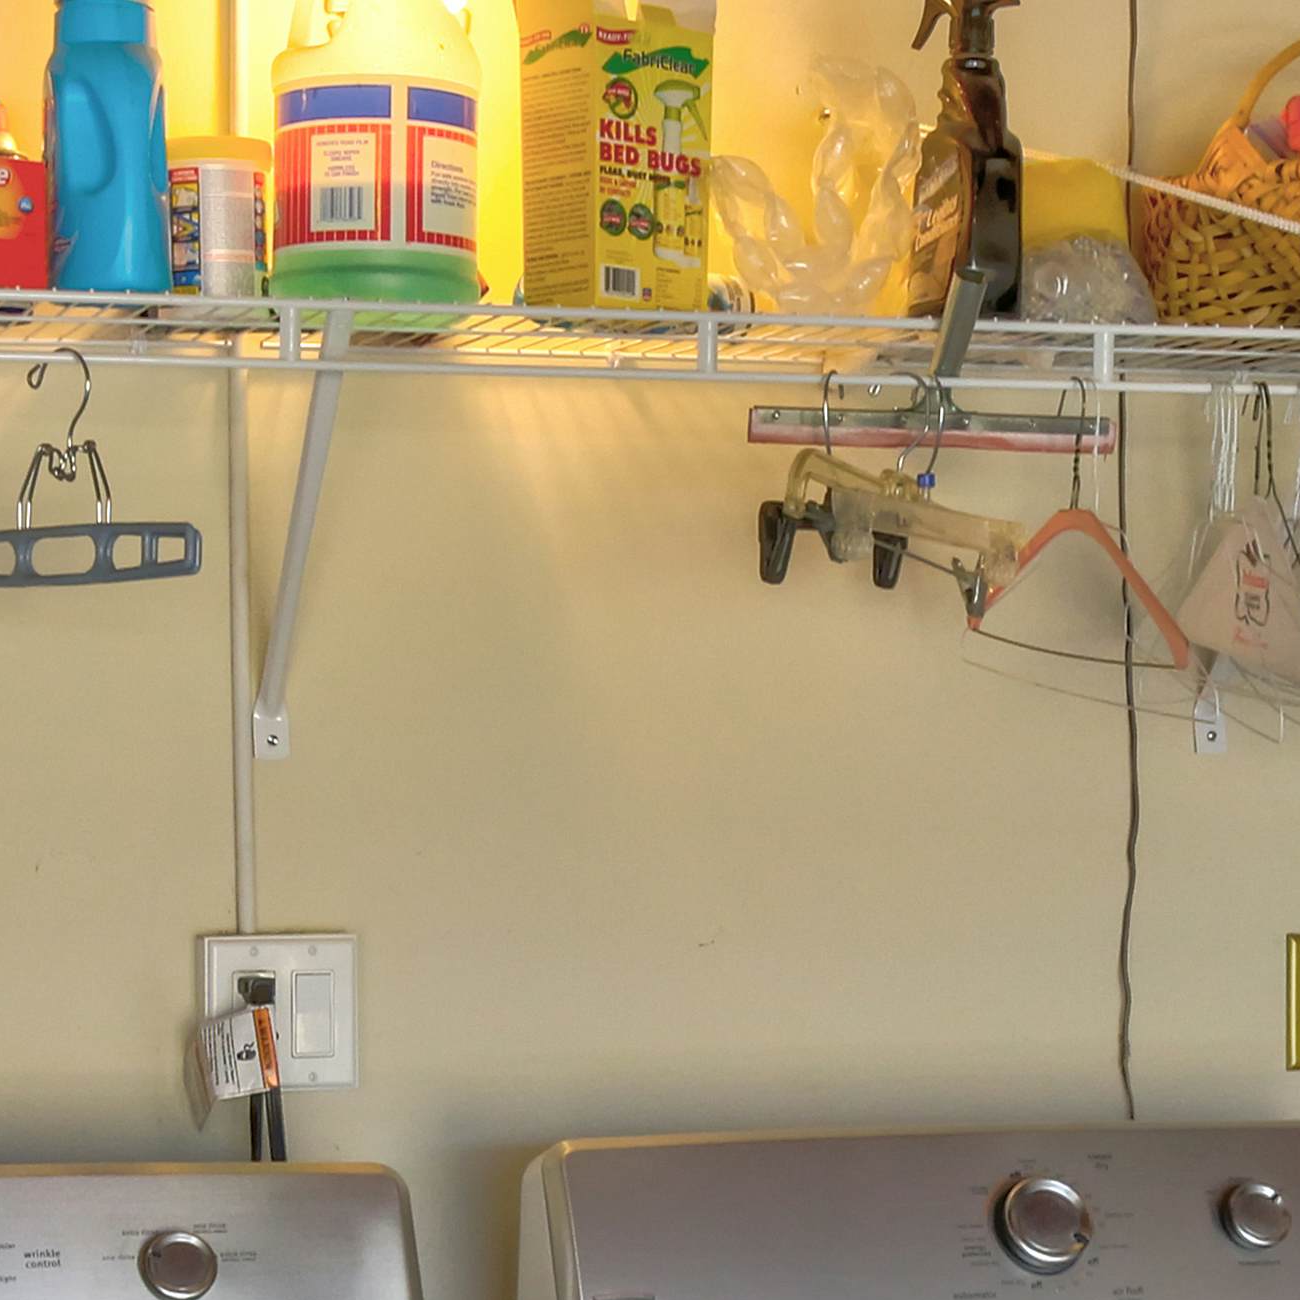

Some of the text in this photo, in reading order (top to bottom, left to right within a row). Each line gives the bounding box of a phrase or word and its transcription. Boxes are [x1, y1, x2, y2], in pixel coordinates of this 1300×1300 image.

[598, 29, 634, 44] READY-T
[622, 48, 697, 75] FabriClear
[600, 119, 657, 146] KILLS
[600, 142, 702, 177] BED BUGS
[431, 160, 464, 174] Directions
[23, 1249, 61, 1258] wrinkle
[25, 1259, 61, 1269] control
[0, 1275, 17, 1284] light
